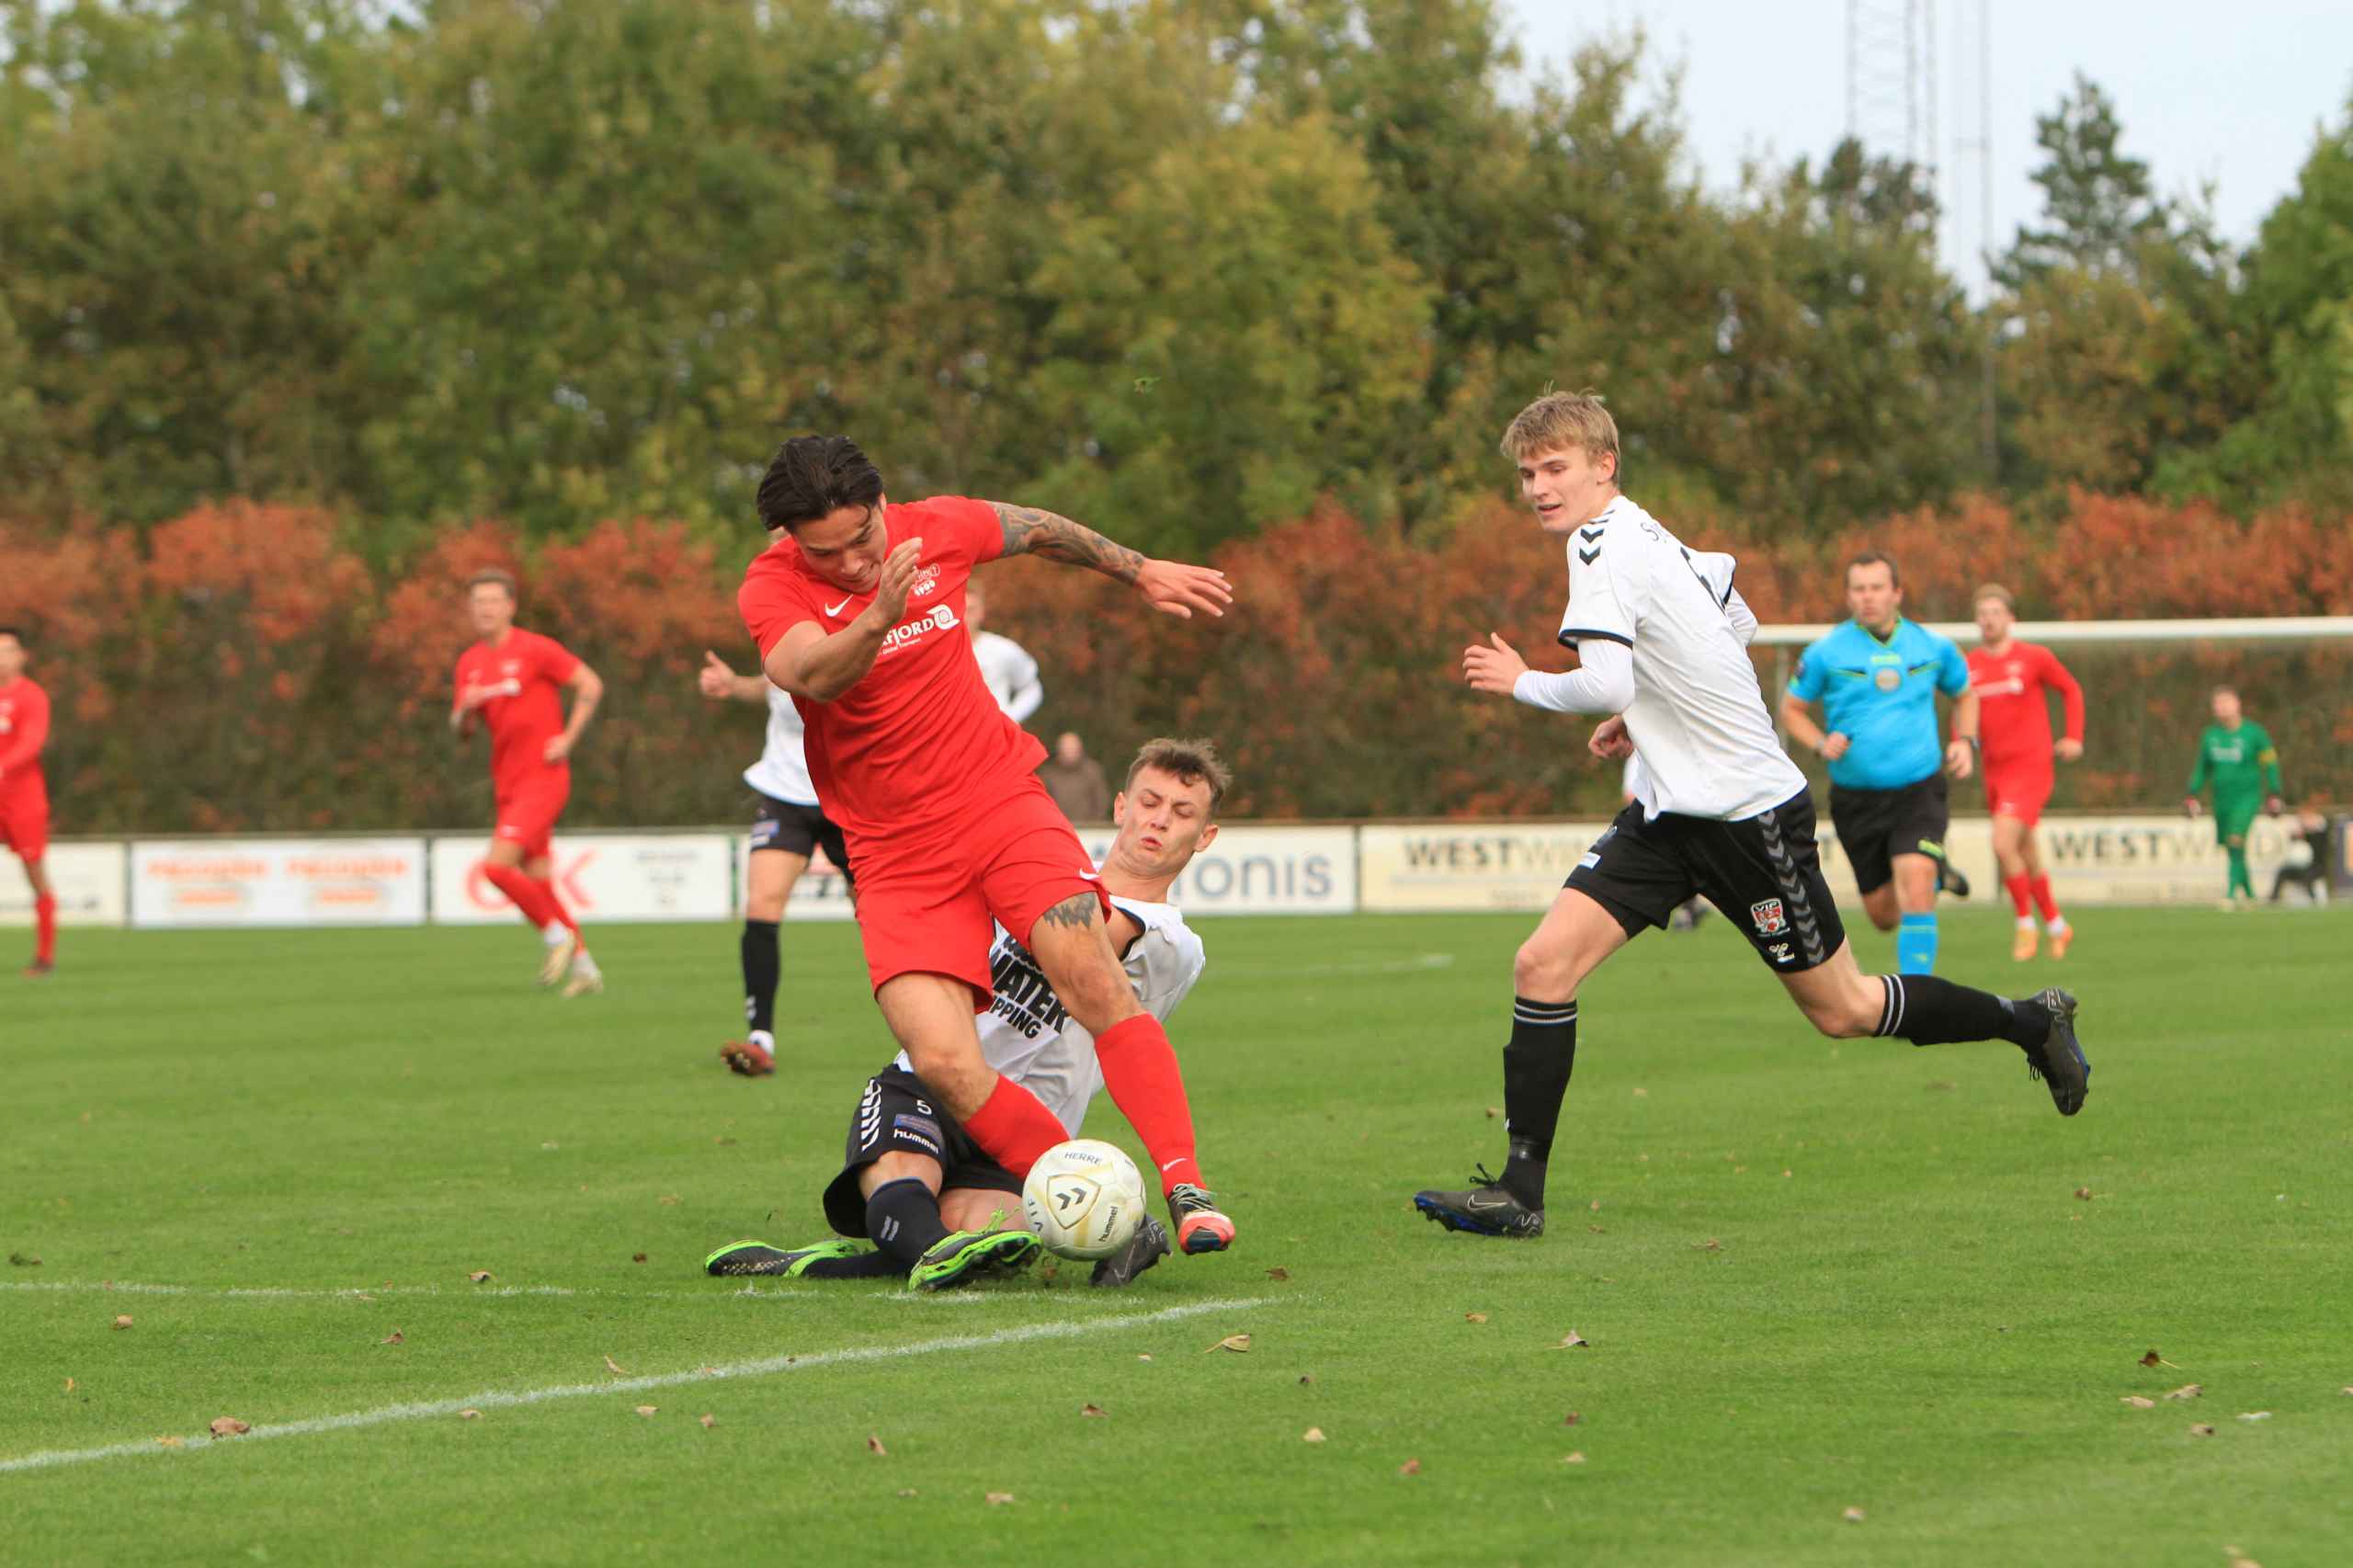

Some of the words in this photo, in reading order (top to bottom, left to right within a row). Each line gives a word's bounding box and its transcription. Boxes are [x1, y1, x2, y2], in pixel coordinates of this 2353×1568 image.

[1172, 855, 1334, 898] onis
[916, 1099, 932, 1115] 5
[893, 1129, 939, 1154] hummel
[1097, 1206, 1118, 1242] hummel
